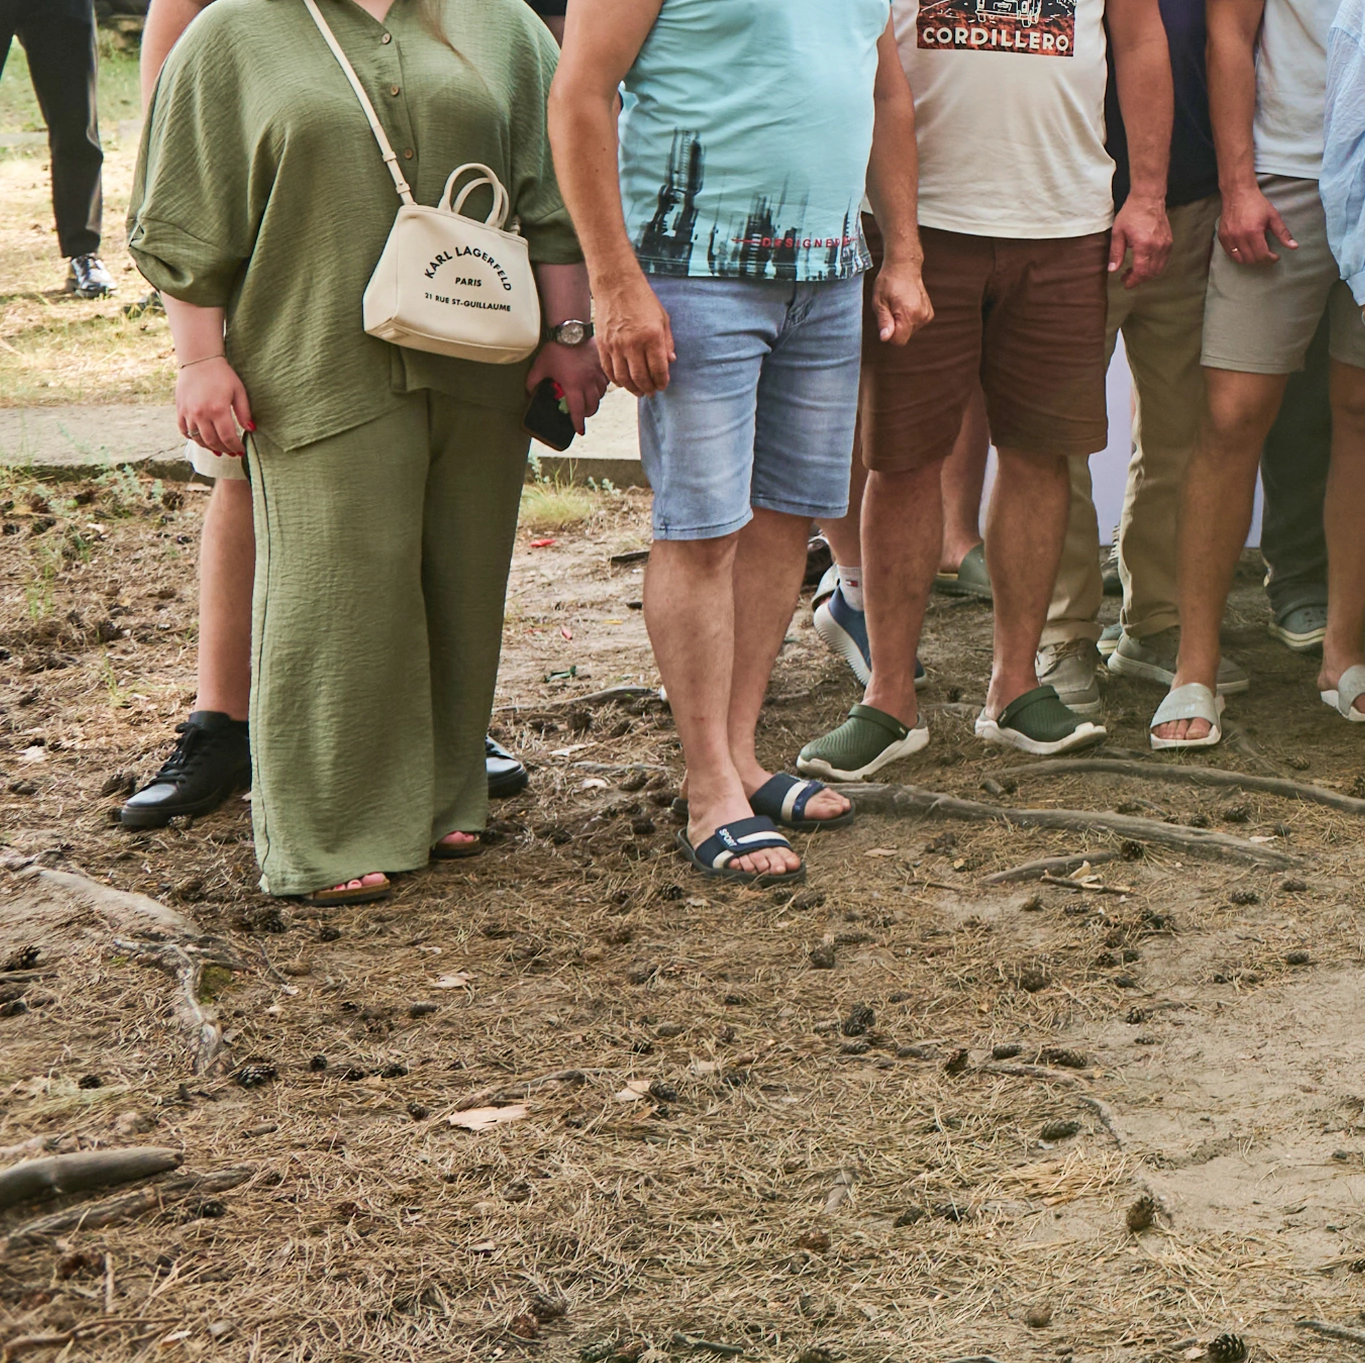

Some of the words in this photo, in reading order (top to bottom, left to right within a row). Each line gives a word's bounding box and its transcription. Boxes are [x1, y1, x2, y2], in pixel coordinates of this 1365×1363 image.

[922, 27, 1069, 52] CORDILLERO
[424, 251, 453, 279] KARL
[455, 245, 512, 291] LAGERFELD
[455, 277, 482, 287] PARIS
[424, 292, 433, 300] 21
[435, 294, 451, 305] RUE
[451, 299, 511, 312] ST-GUILLAUME
